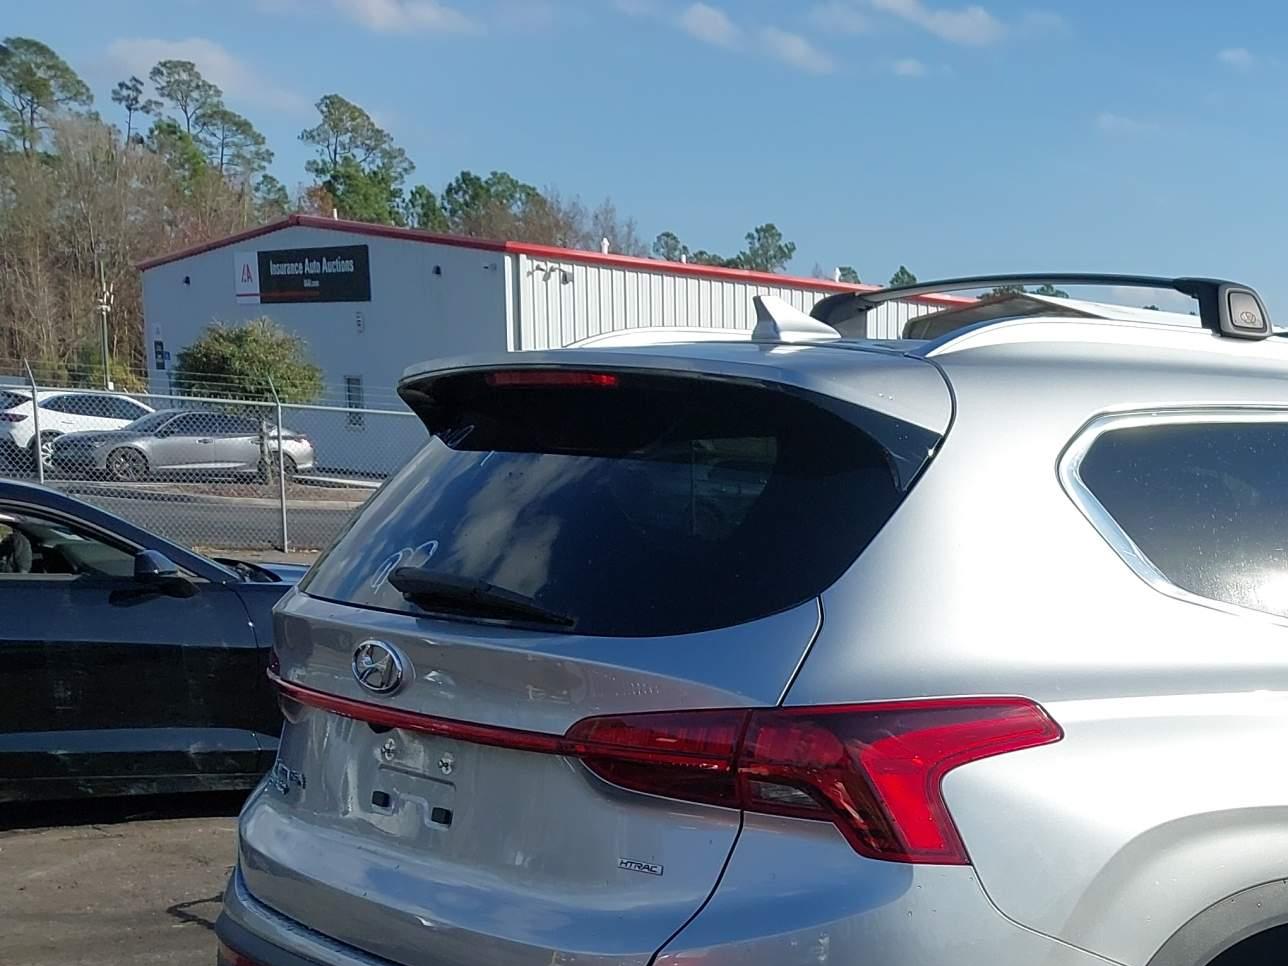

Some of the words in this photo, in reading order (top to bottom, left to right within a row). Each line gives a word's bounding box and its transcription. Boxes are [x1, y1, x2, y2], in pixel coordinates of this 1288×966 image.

[269, 260, 303, 276] Insurance
[304, 257, 320, 274] Auto
[321, 256, 354, 273] Auctions
[619, 860, 658, 873] HTRAC
